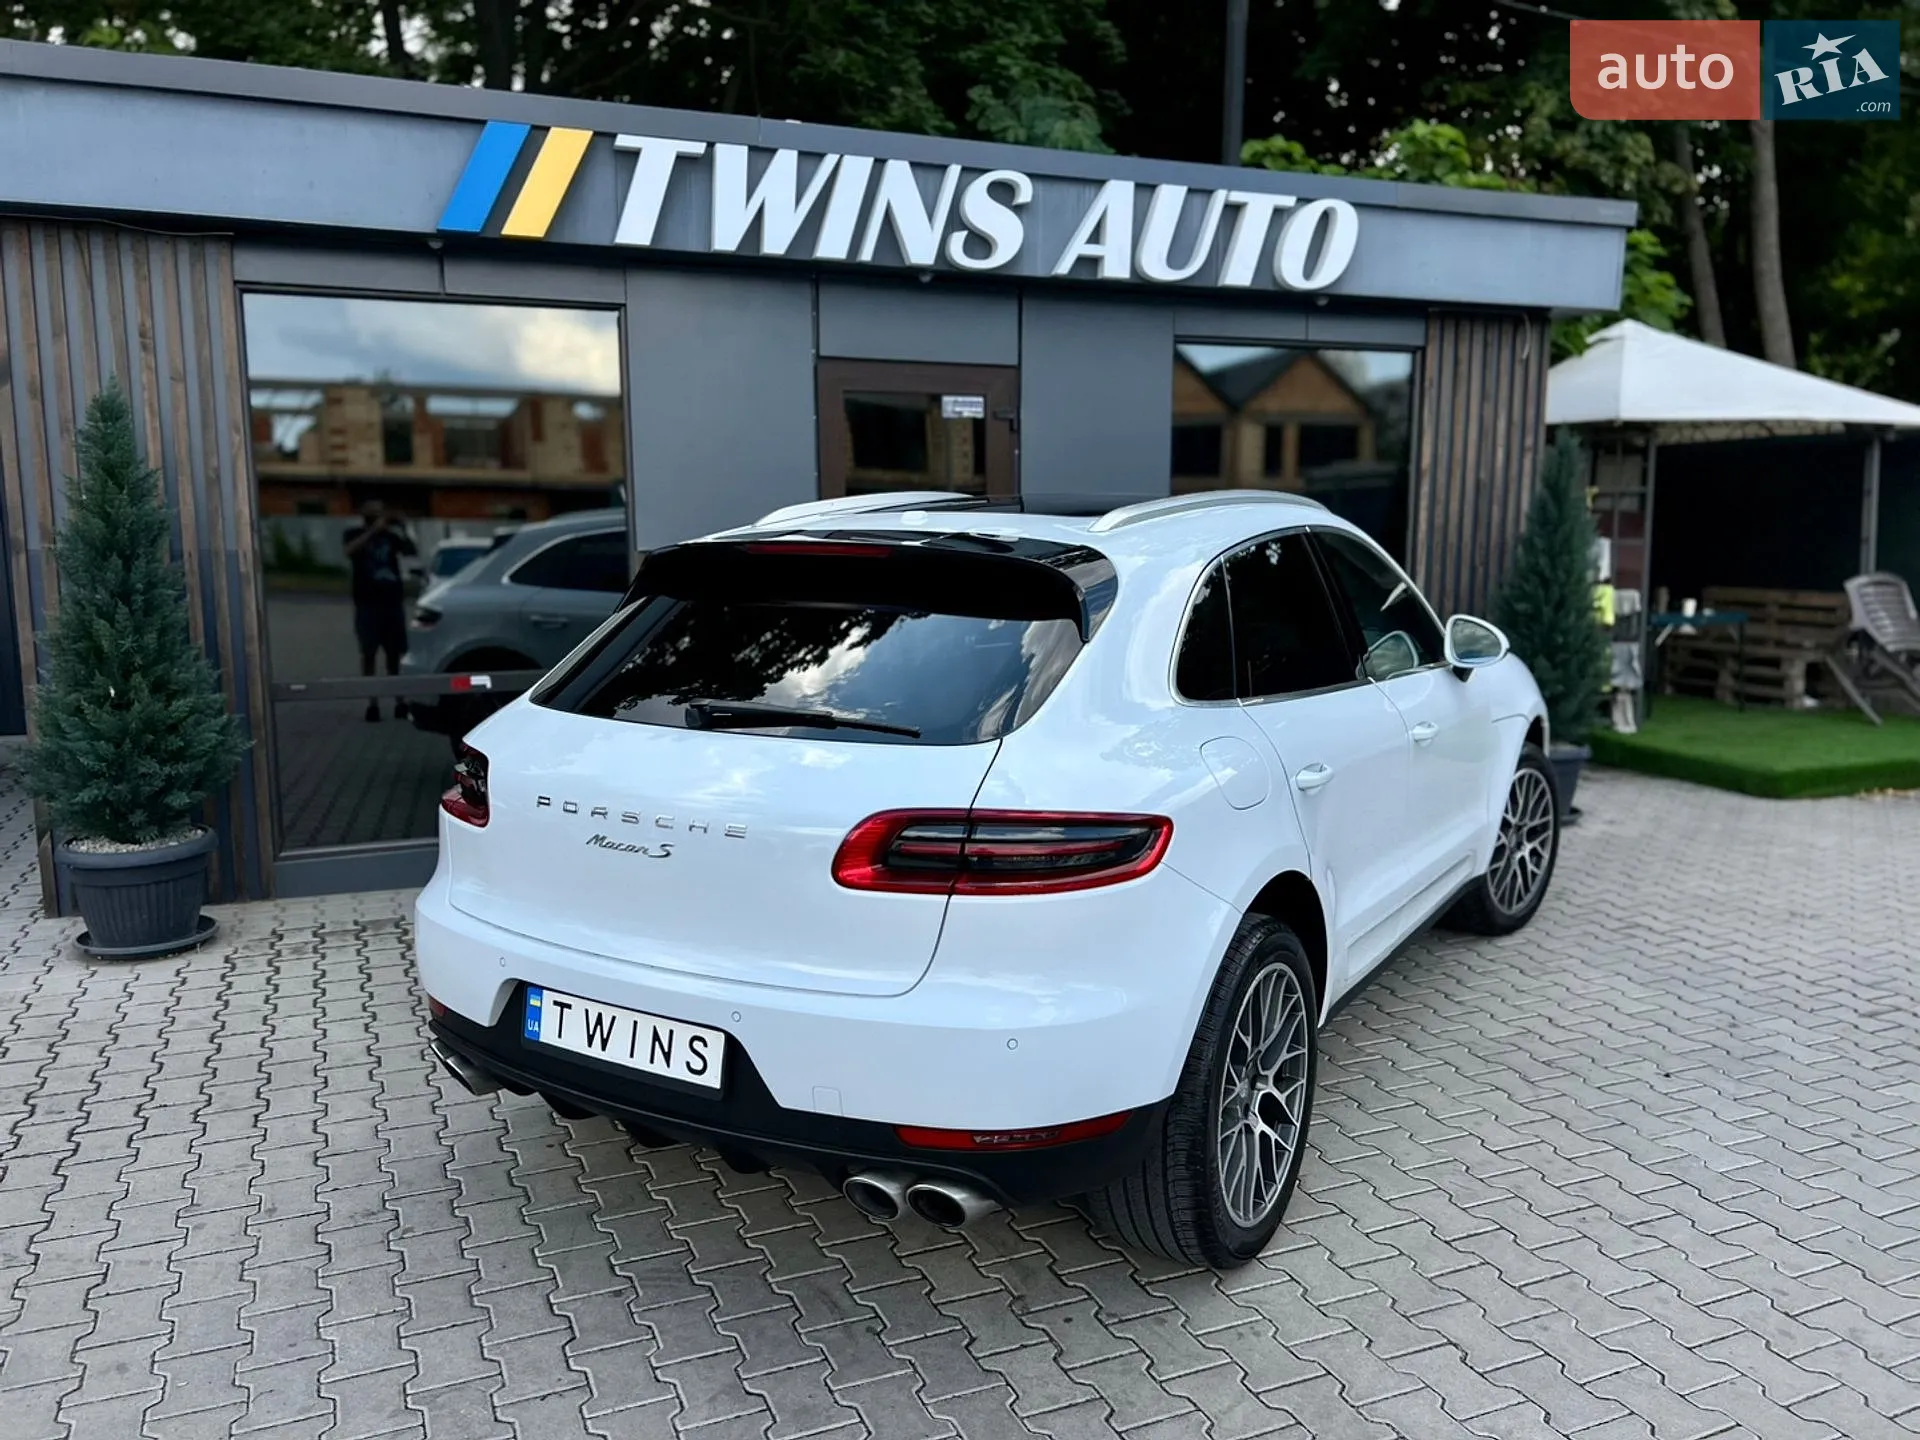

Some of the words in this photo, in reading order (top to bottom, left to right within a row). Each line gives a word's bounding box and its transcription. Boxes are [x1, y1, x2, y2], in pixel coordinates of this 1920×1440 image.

[613, 133, 1033, 271] TWINS
[1051, 179, 1359, 291] AUTO
[537, 795, 748, 839] PORSCHE
[586, 833, 649, 855] Macan
[648, 843, 675, 858] S
[527, 1019, 540, 1033] UA
[553, 1000, 708, 1076] TWINS
